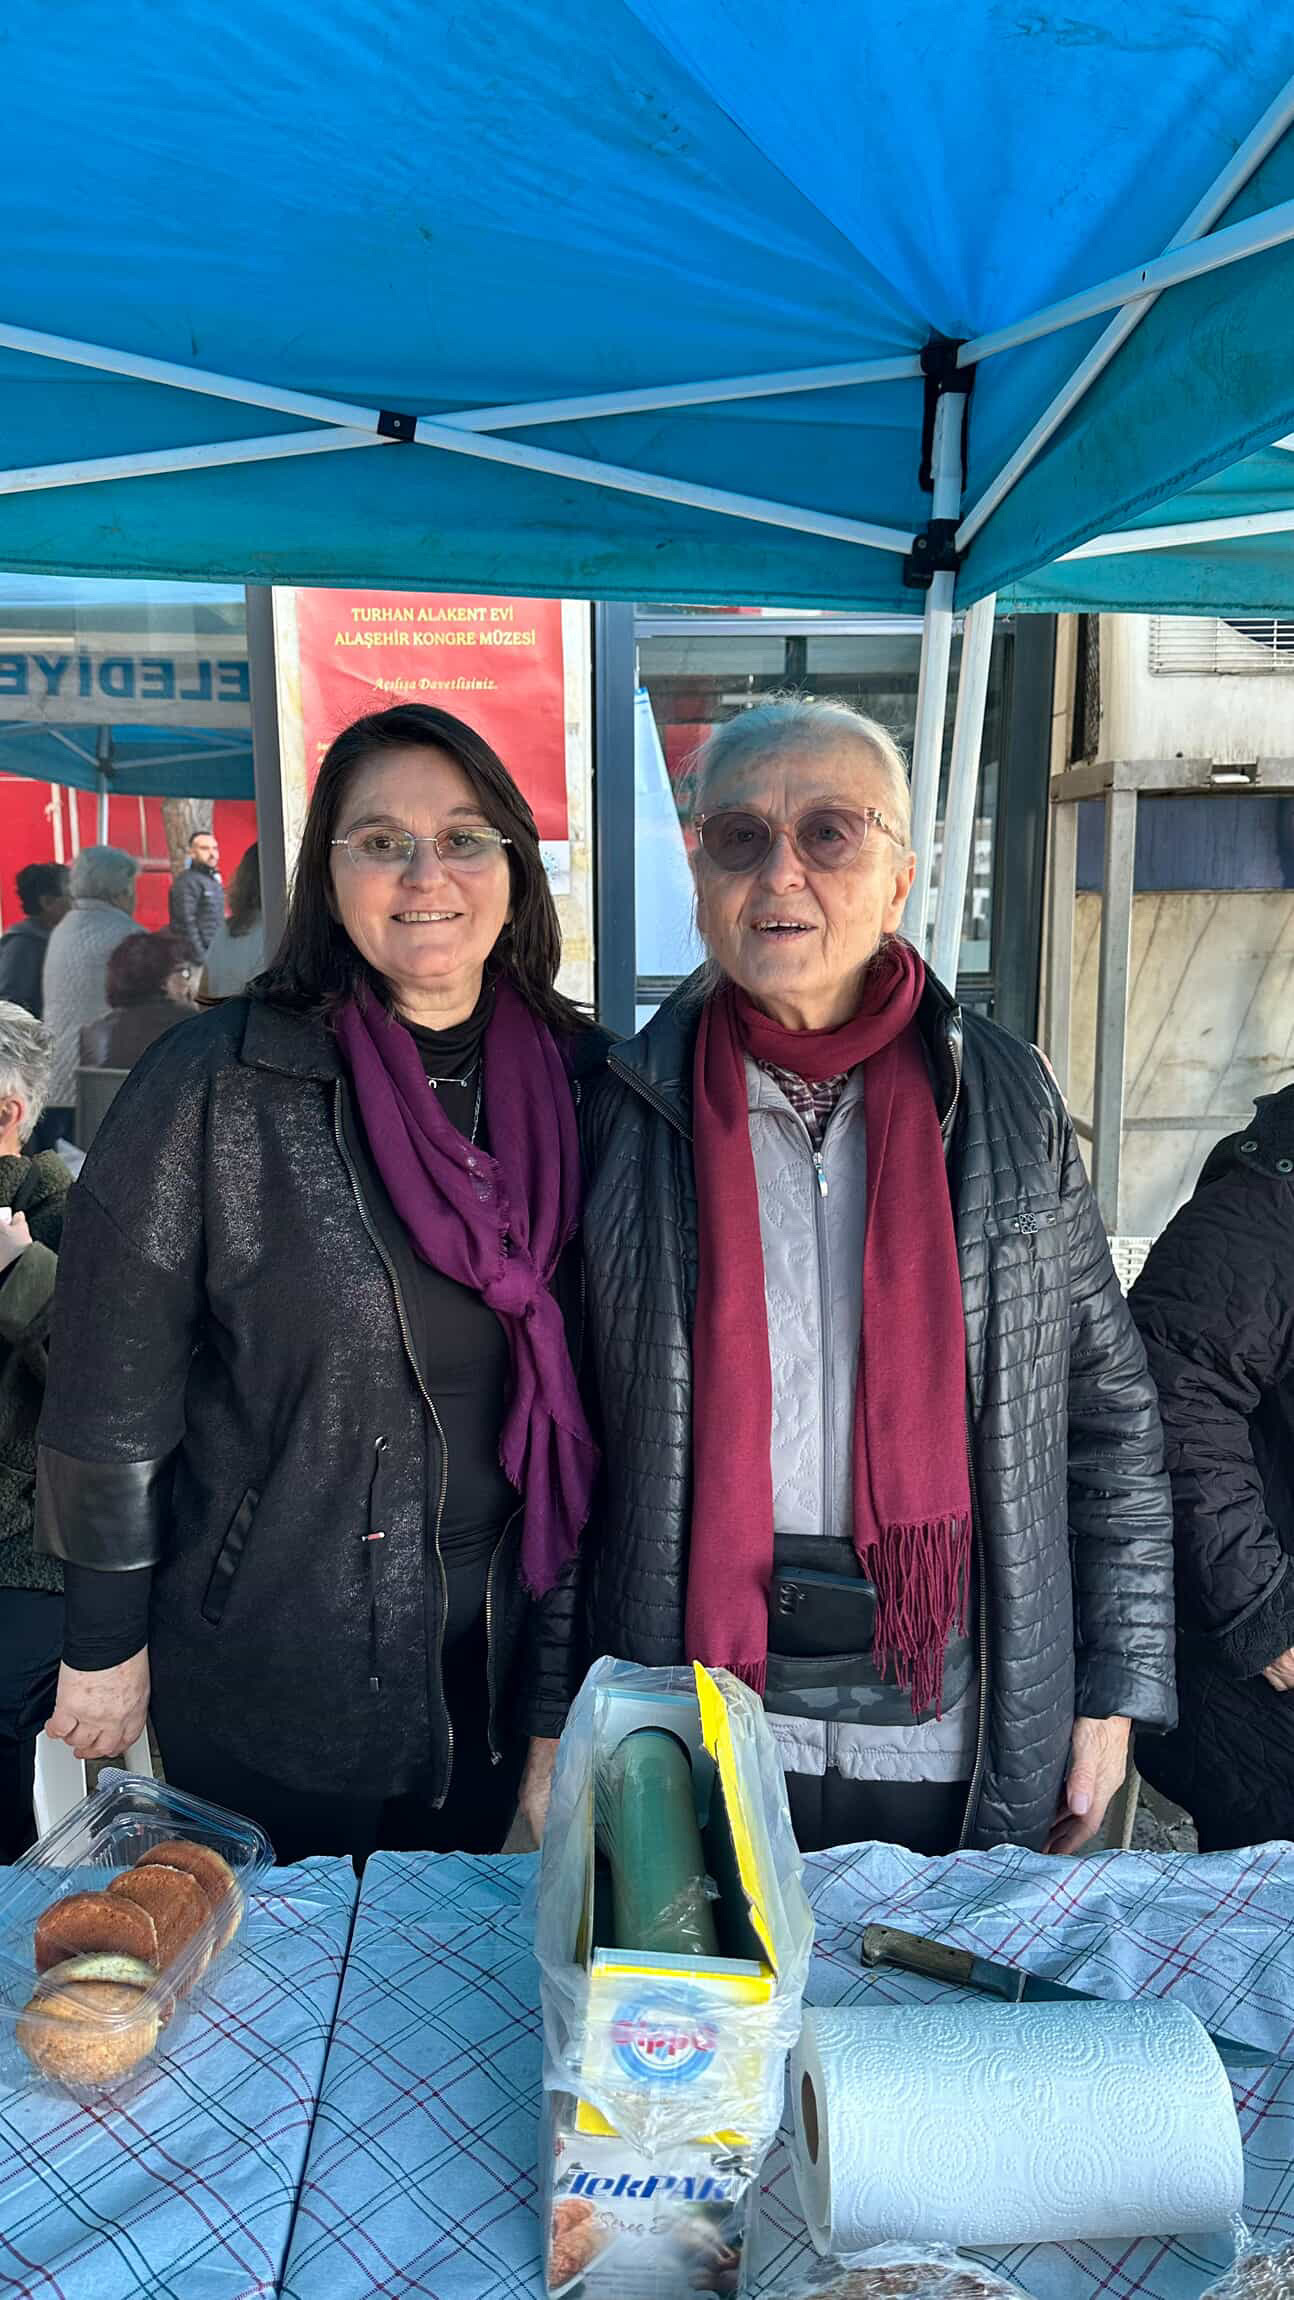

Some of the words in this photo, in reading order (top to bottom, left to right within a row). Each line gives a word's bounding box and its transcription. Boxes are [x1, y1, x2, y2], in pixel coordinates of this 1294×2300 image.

[351, 607, 414, 622] TURHAN
[417, 607, 487, 622] ALAKENT
[490, 604, 513, 622] EVİ
[335, 629, 409, 648] ALAŞEHİR
[413, 631, 476, 646] KONGRE
[480, 628, 536, 646] MÜZESİ
